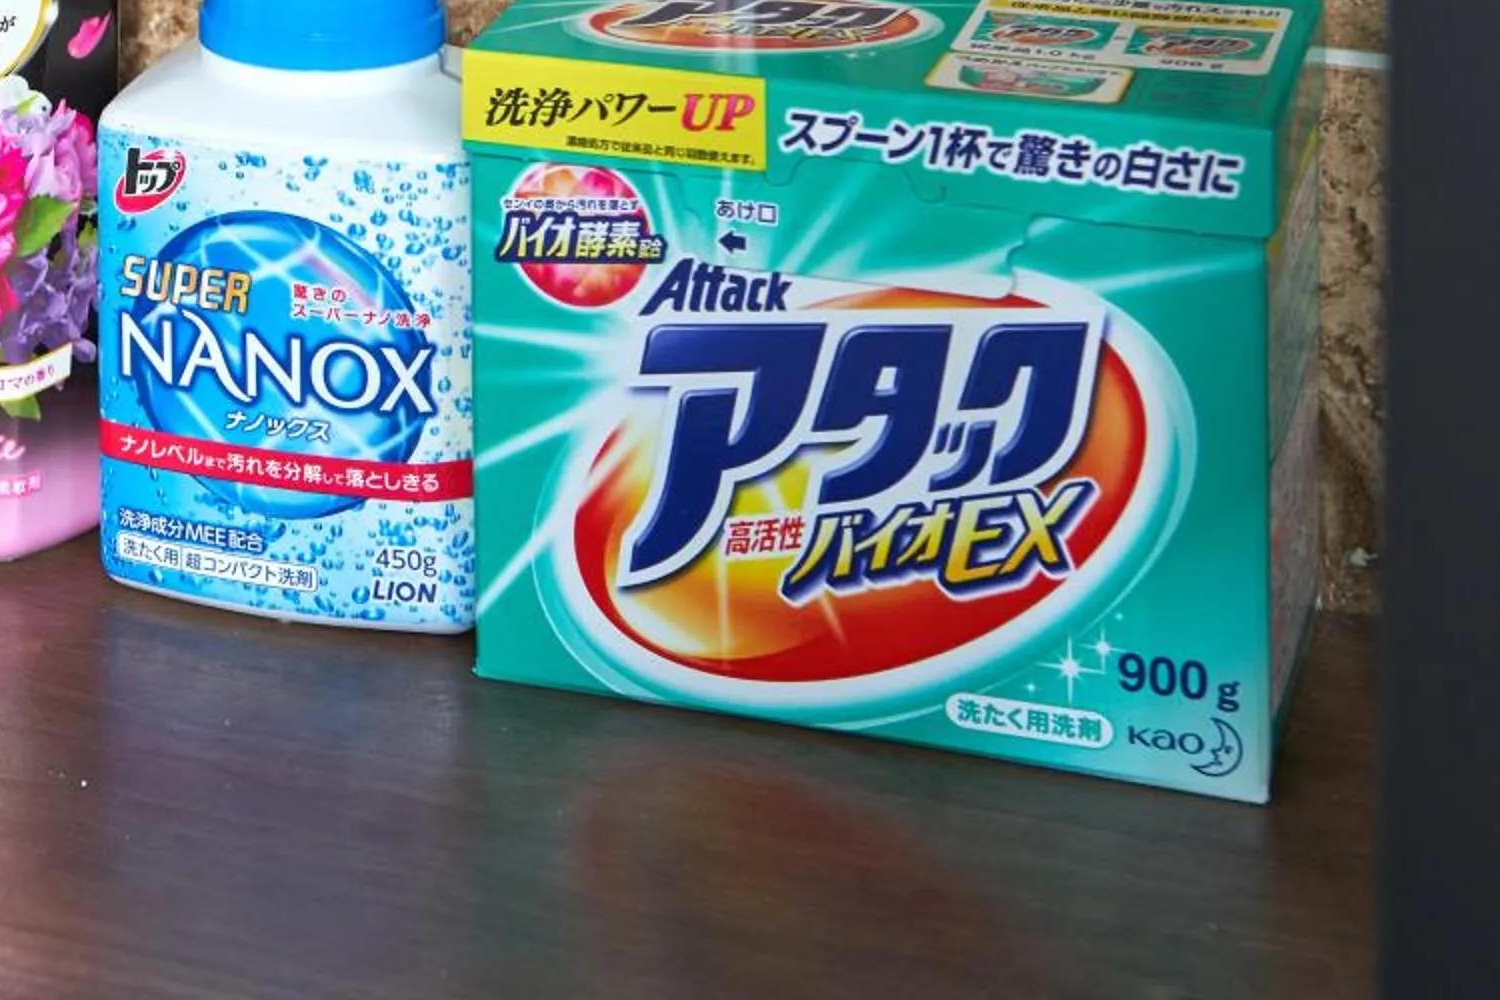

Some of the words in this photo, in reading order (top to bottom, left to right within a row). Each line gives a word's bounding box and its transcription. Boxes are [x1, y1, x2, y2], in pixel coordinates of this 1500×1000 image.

[485, 86, 757, 133] 洗浄パワーUP
[124, 147, 181, 197] トップ
[784, 113, 1241, 193] スプーン1杯で驚きの白さに
[716, 200, 778, 223] あけ口
[120, 255, 252, 314] SUPER
[292, 283, 347, 303] 驚きの
[639, 257, 793, 316] Attack
[292, 303, 432, 329] スーパーナノ洗浄
[119, 311, 437, 413] NANOX
[224, 410, 332, 442] ナノックス
[630, 321, 1090, 574] アタック
[119, 434, 441, 492] ナノレベルまで汚れを分解して落としきる
[118, 507, 265, 553] 洗浄成分MEE配合
[724, 516, 805, 557] 高活性
[786, 482, 1094, 590] バイオEX
[122, 537, 179, 566] 洗たく用
[185, 552, 315, 590] 超コンパクト洗剤
[374, 549, 438, 577] 450g
[372, 581, 438, 604] LION
[1117, 652, 1208, 700] 900
[1217, 680, 1241, 713] g
[957, 698, 1102, 743] 洗たく用洗剤
